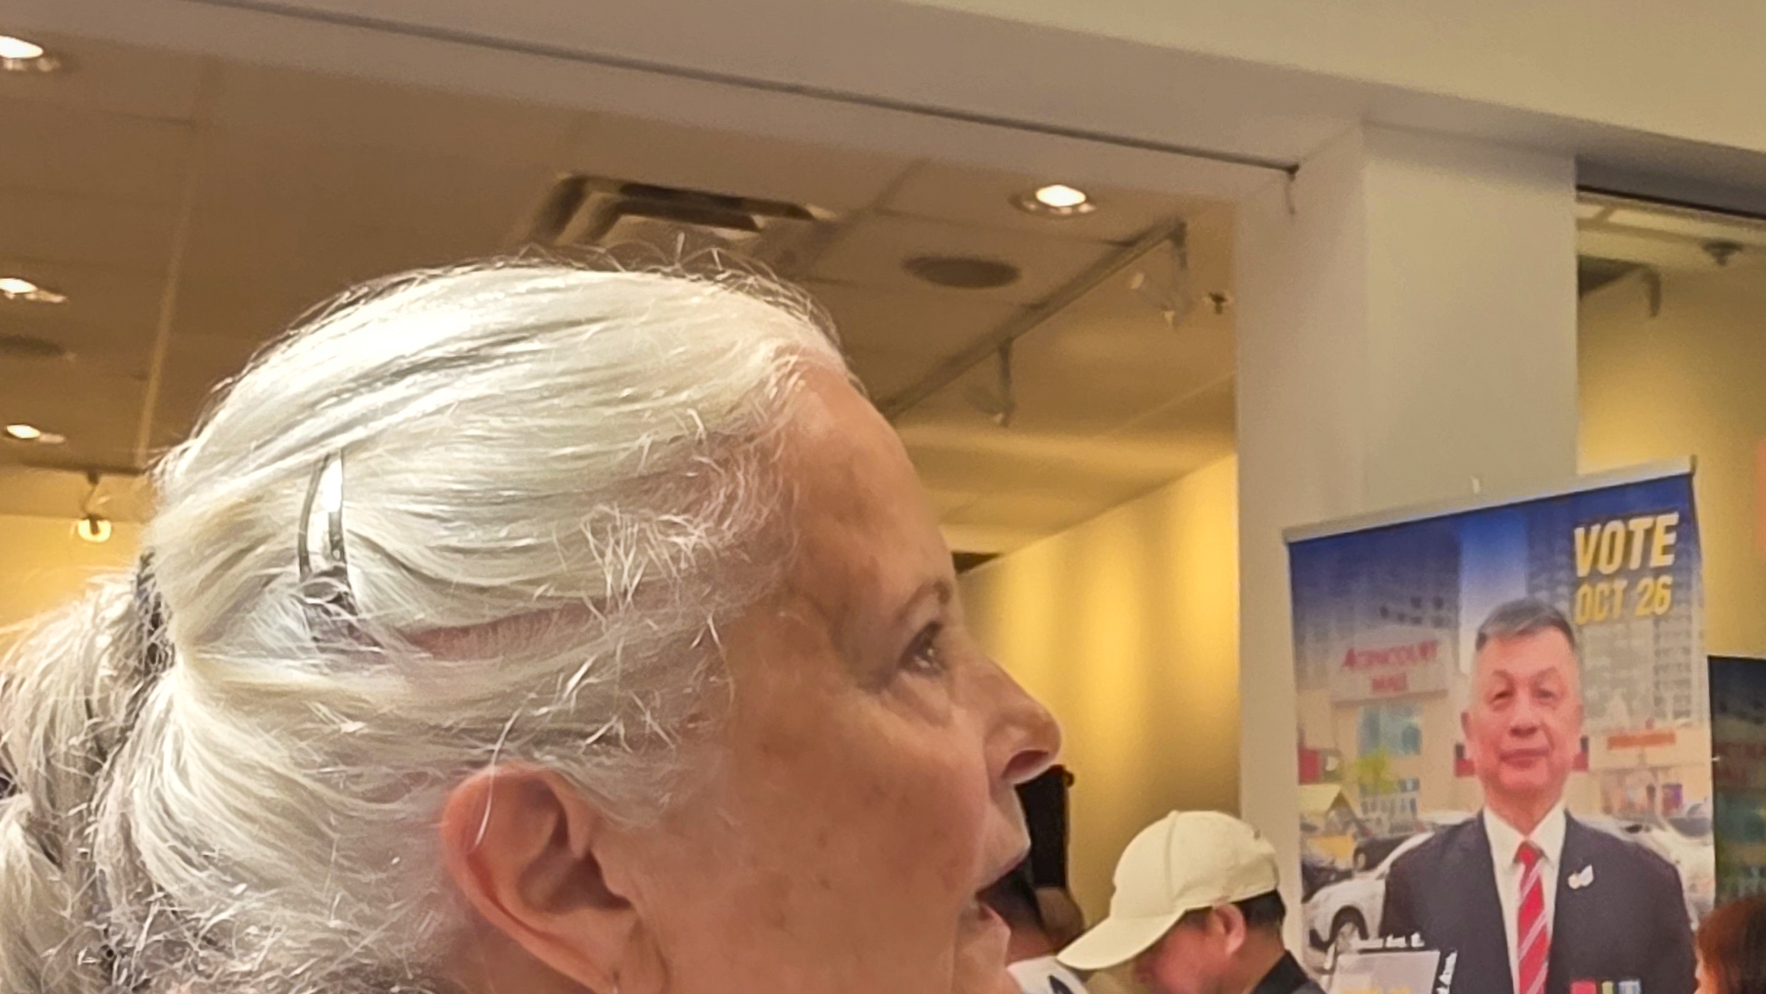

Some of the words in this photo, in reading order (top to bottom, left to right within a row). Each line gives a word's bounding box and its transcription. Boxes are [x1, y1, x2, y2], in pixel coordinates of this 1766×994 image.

[1573, 511, 1680, 578] VOTE
[1573, 579, 1629, 626] OCT
[1635, 574, 1673, 617] 26
